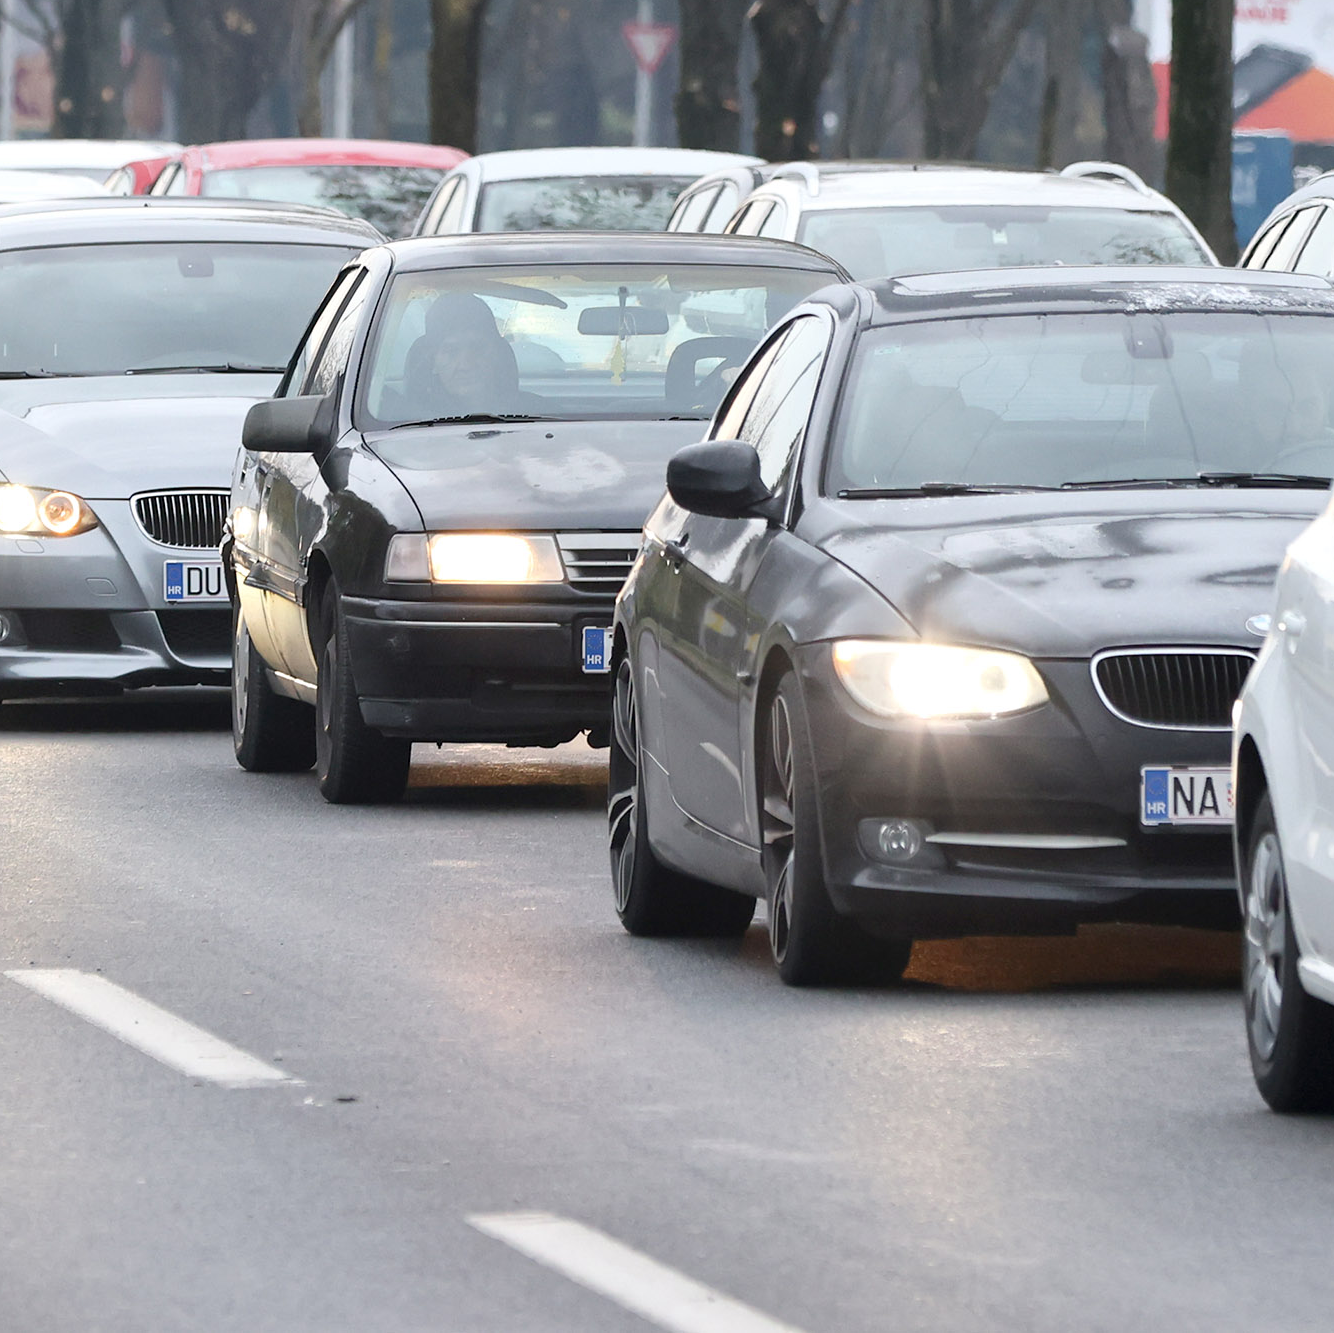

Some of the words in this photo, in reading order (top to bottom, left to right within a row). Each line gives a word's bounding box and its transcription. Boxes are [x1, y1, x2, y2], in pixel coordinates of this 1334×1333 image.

[168, 586, 182, 595] HR
[187, 567, 221, 596] DU
[587, 655, 602, 665] HR
[1147, 802, 1166, 814] HR
[1173, 777, 1220, 815] NA
